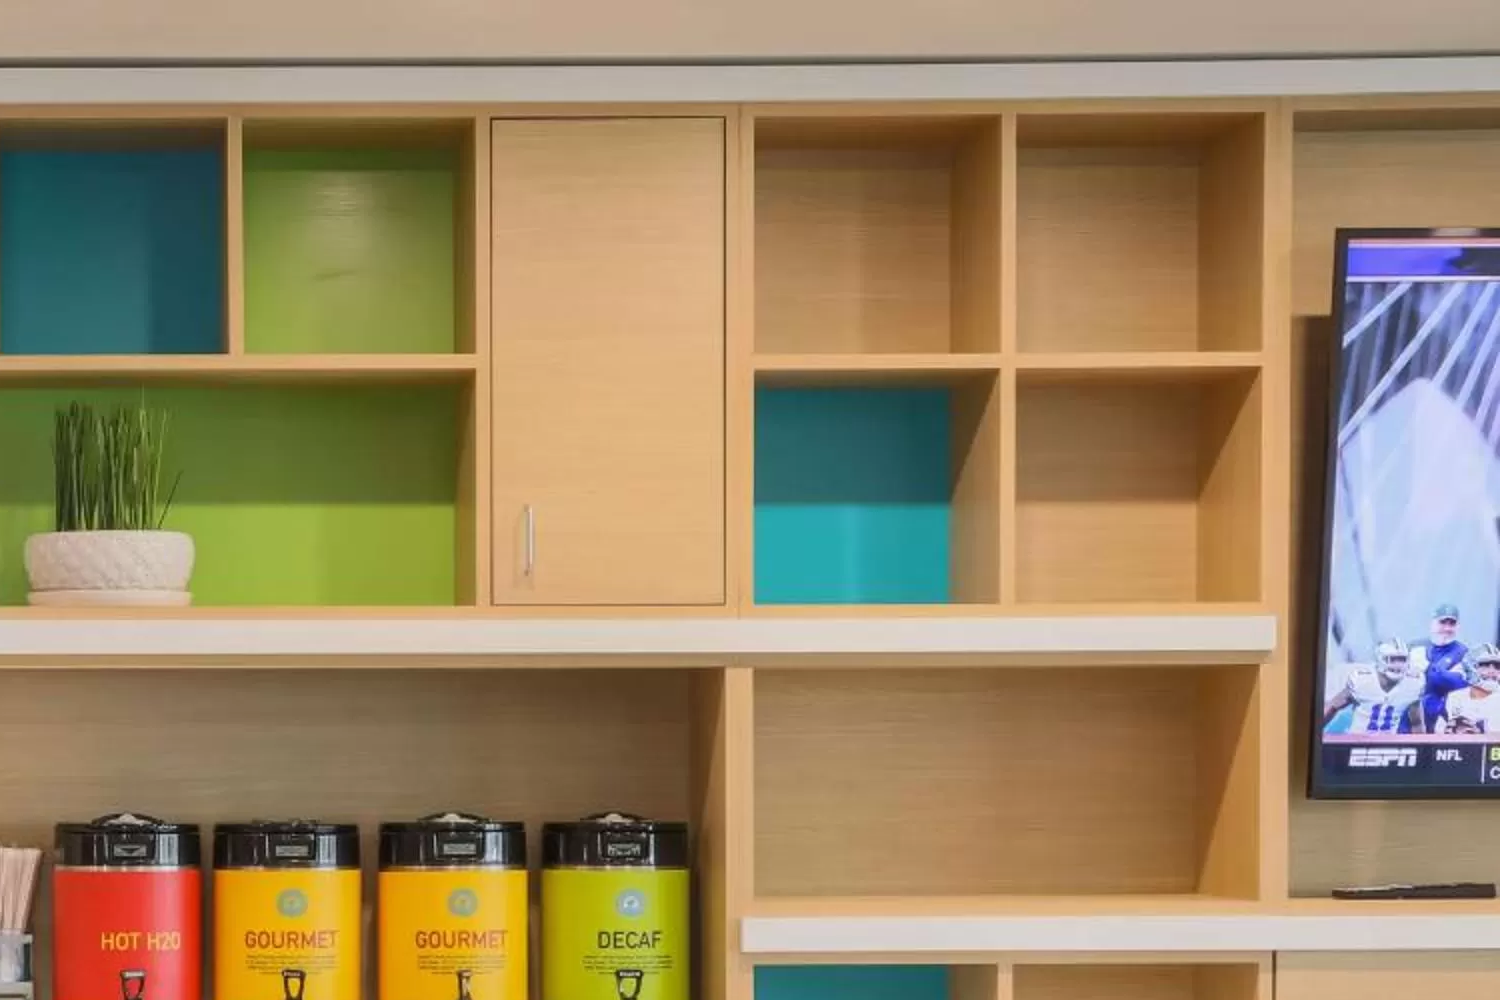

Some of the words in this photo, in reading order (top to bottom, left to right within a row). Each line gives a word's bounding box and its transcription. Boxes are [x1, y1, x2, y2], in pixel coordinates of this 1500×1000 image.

[1349, 747, 1417, 767] ESPN
[1435, 749, 1463, 761] NFL
[101, 931, 142, 951] HOT
[245, 930, 339, 950] GOURMET
[415, 930, 508, 950] GOURMET
[597, 930, 663, 950] DECAF
